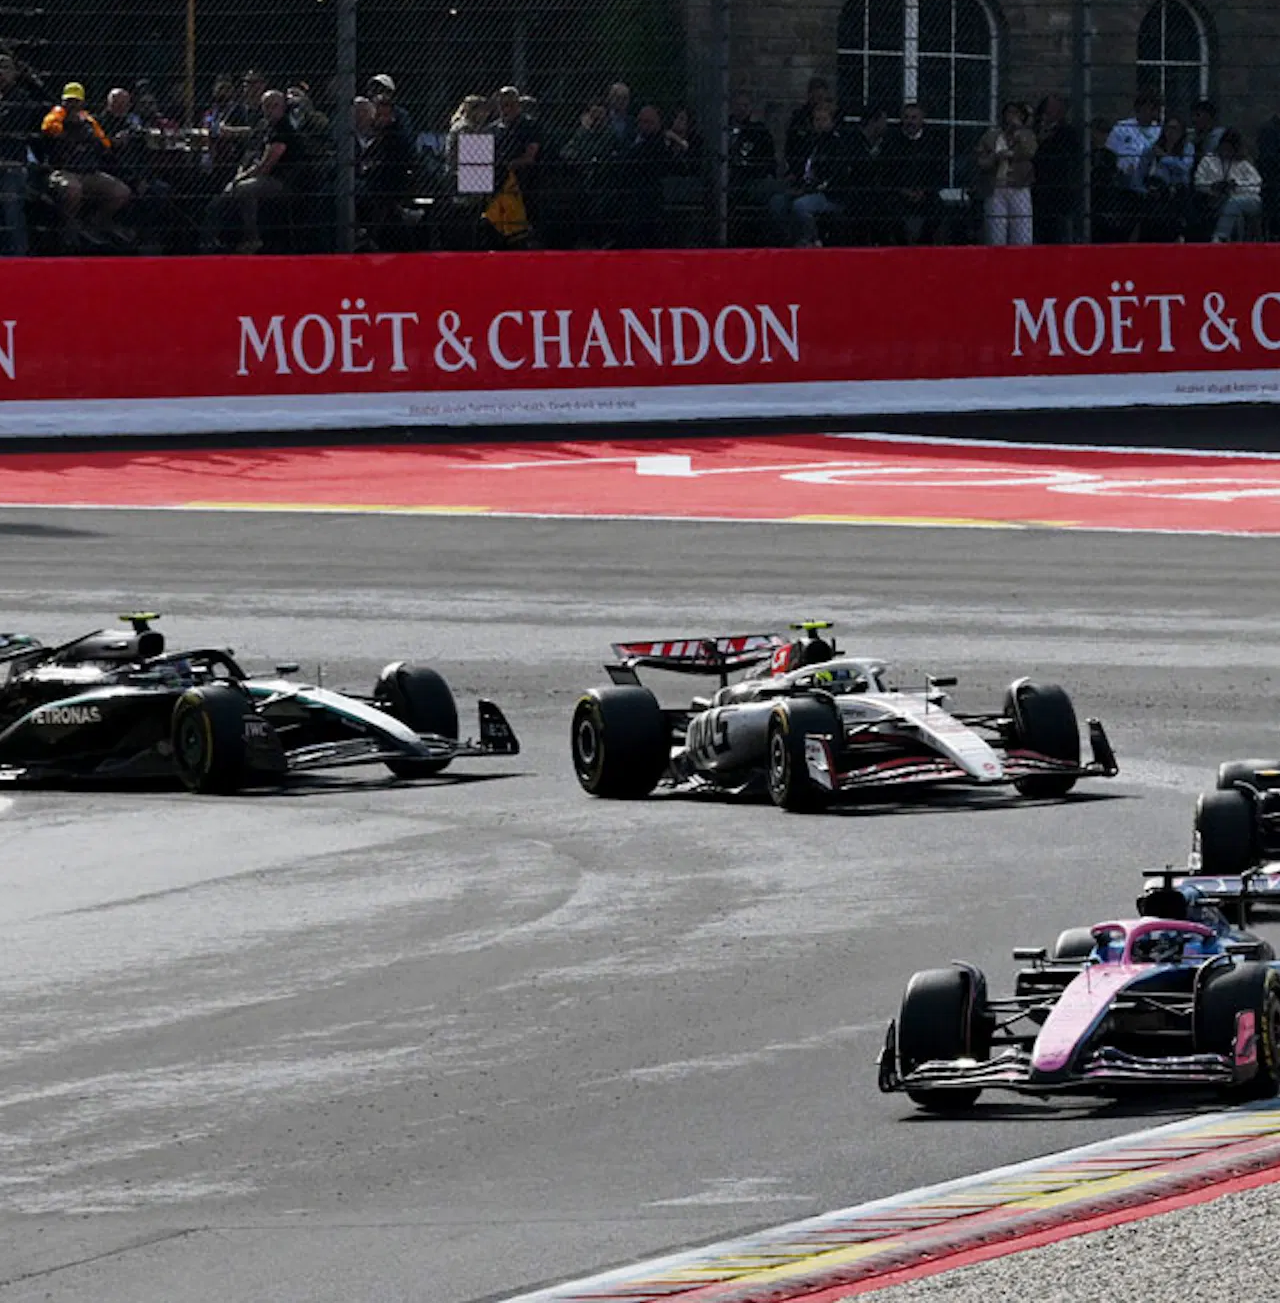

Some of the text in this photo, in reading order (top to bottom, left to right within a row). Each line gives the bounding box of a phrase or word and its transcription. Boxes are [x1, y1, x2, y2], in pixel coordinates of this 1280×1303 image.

[236, 298, 800, 376] MOËT & CHANDON
[1012, 280, 1186, 357] MOËT
[1199, 291, 1241, 352] &
[31, 705, 102, 725] PETRONAS
